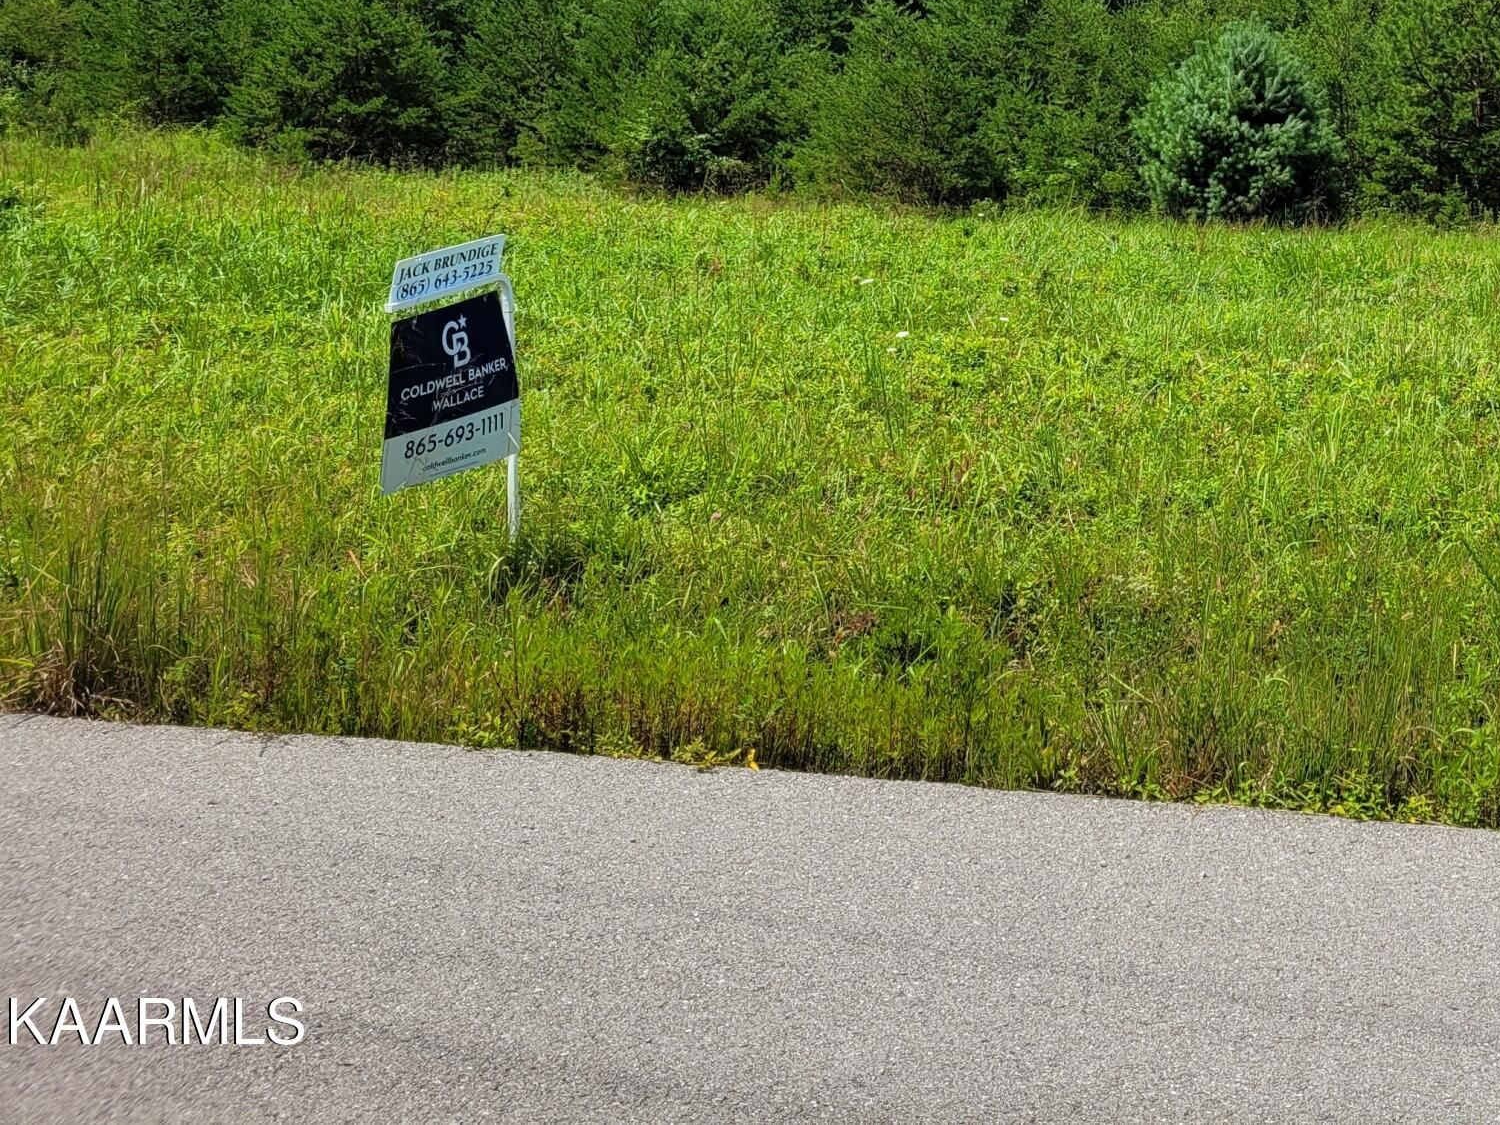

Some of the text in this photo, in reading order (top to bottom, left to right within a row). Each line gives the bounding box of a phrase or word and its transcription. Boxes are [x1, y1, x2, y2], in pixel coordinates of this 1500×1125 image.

[396, 260, 494, 301] (865) 643-5225
[397, 243, 499, 285] JACK BRUNDIGE
[401, 358, 506, 401] COLDWELL BANKER
[432, 386, 484, 412] WALLACE
[404, 412, 504, 459] 865-693-1111
